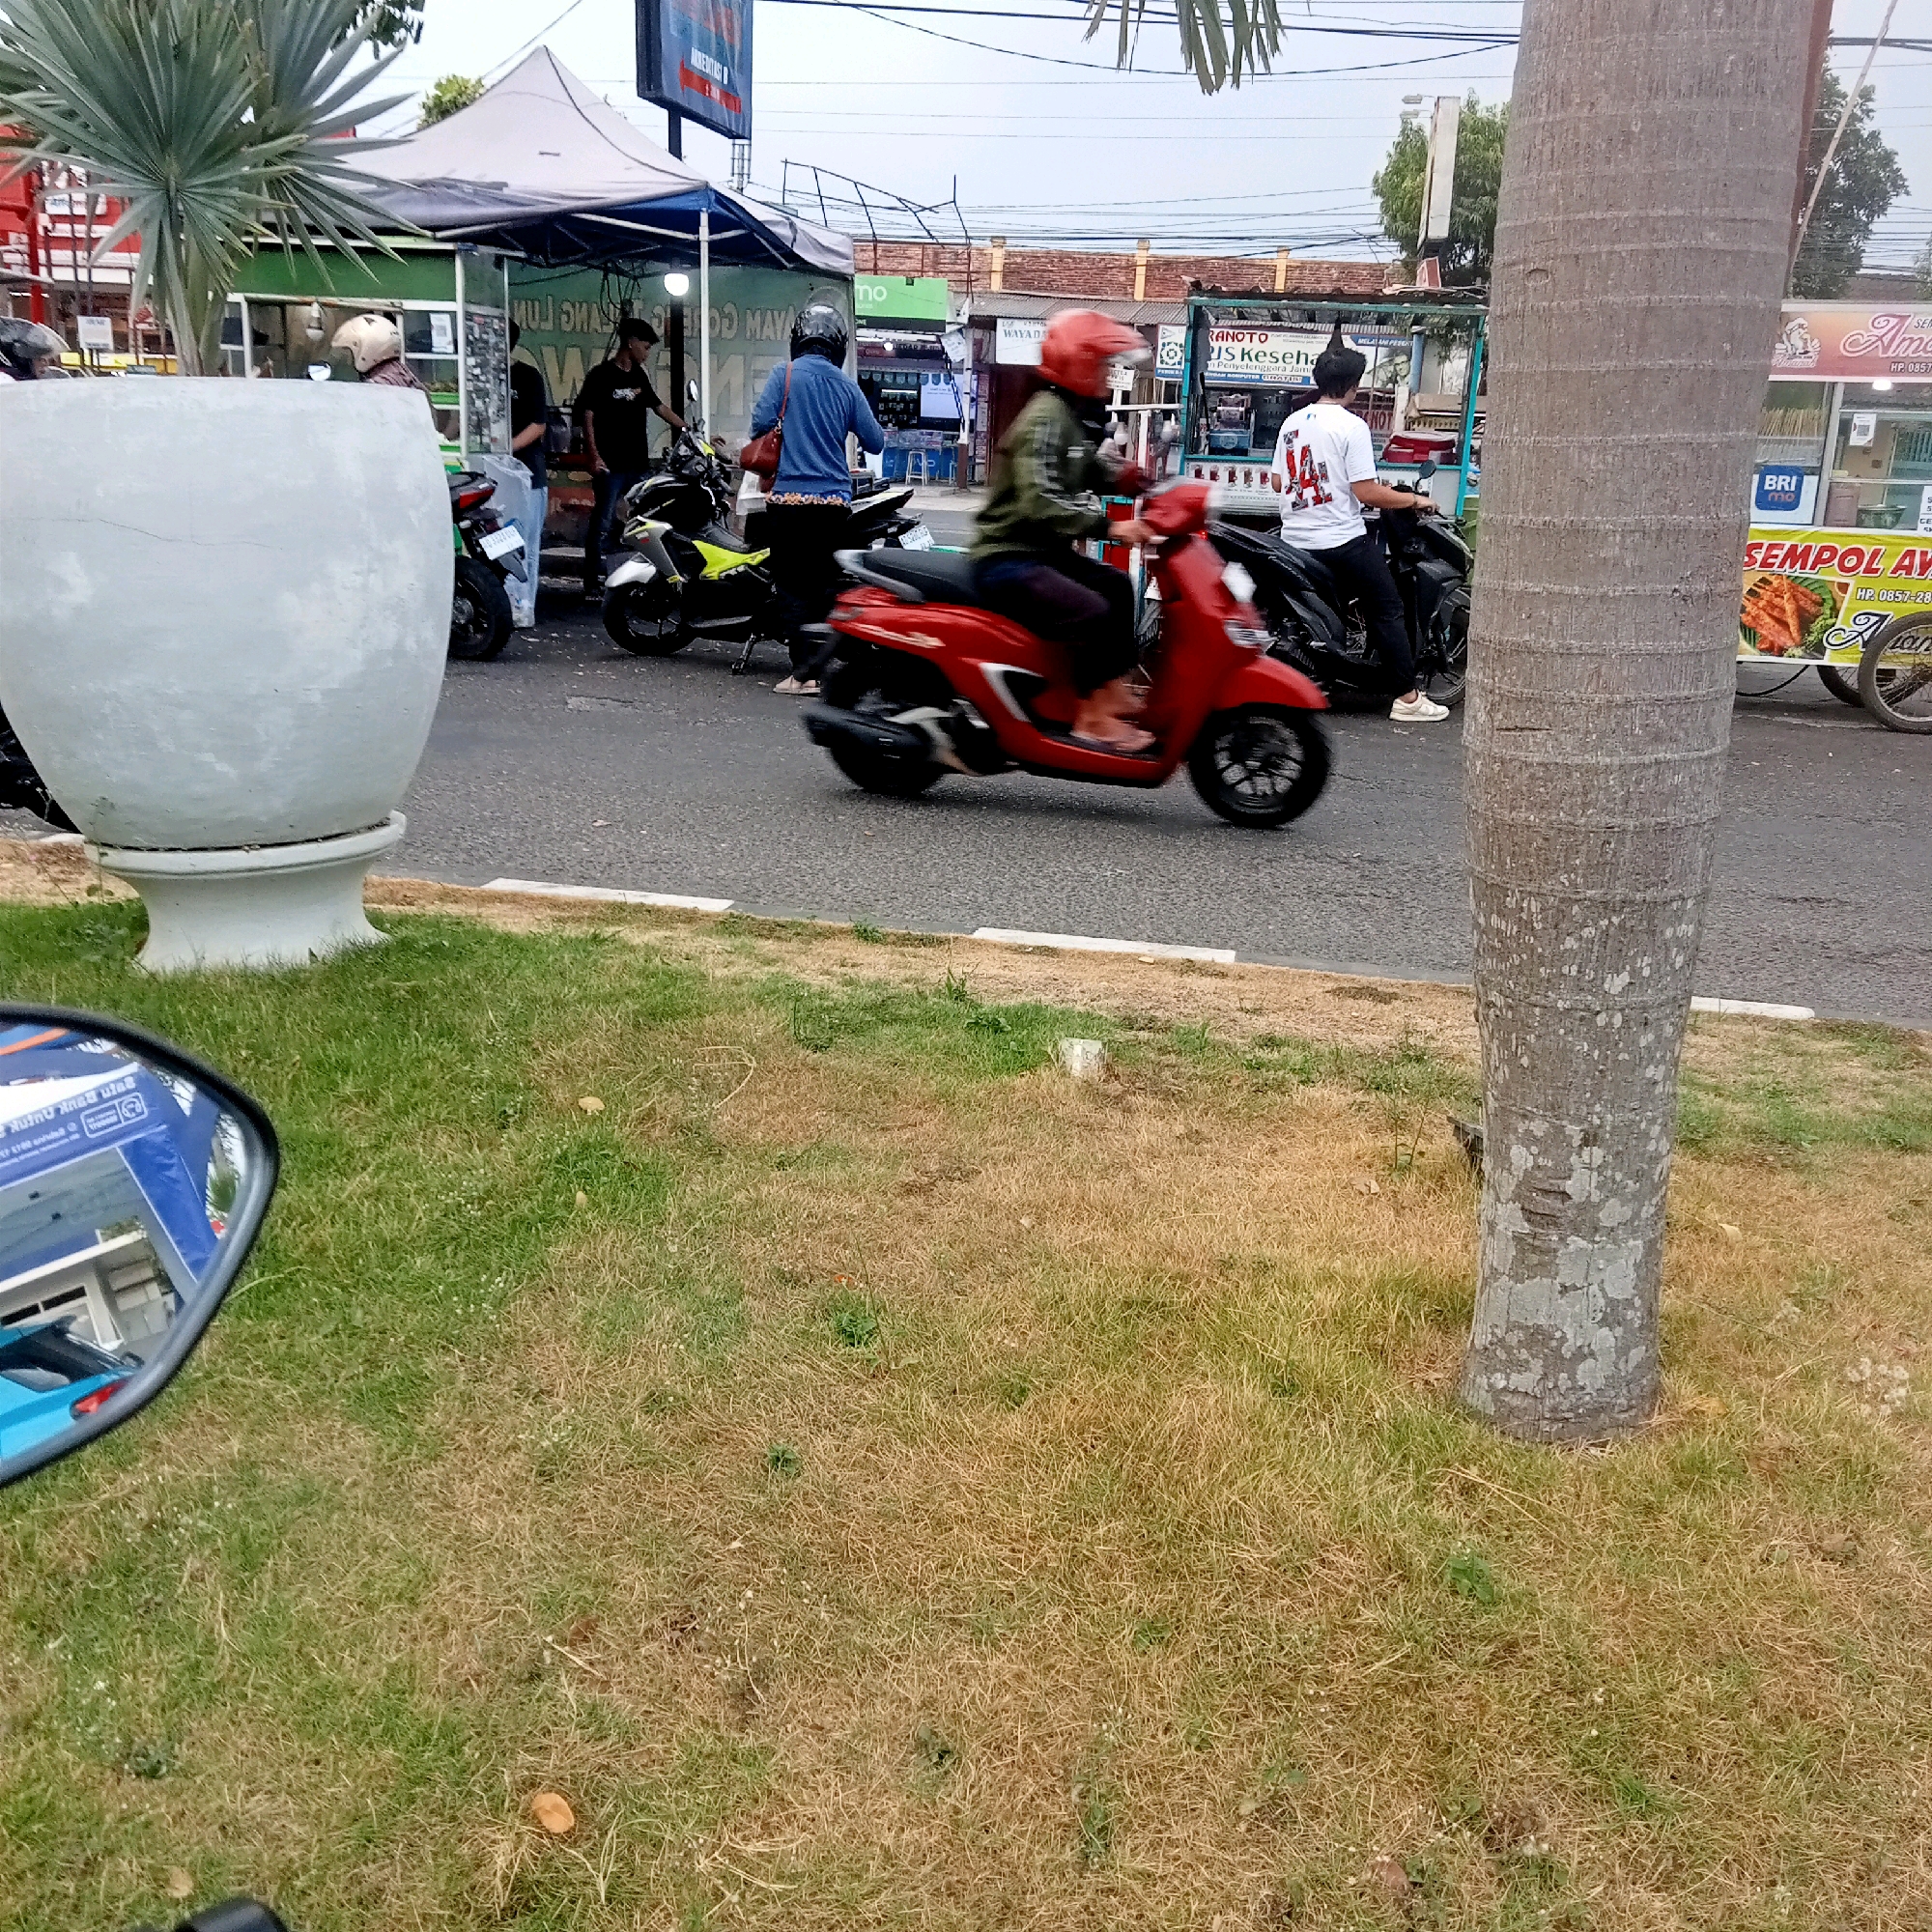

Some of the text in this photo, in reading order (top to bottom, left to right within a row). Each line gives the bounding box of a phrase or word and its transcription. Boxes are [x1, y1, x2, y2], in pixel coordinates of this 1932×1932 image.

[1217, 361, 1287, 373] Penyelenggara
[1764, 474, 1798, 492] BRI
[1768, 491, 1795, 502] mo
[1743, 542, 1883, 578] SEMPOL
[1857, 587, 1875, 601] HP.
